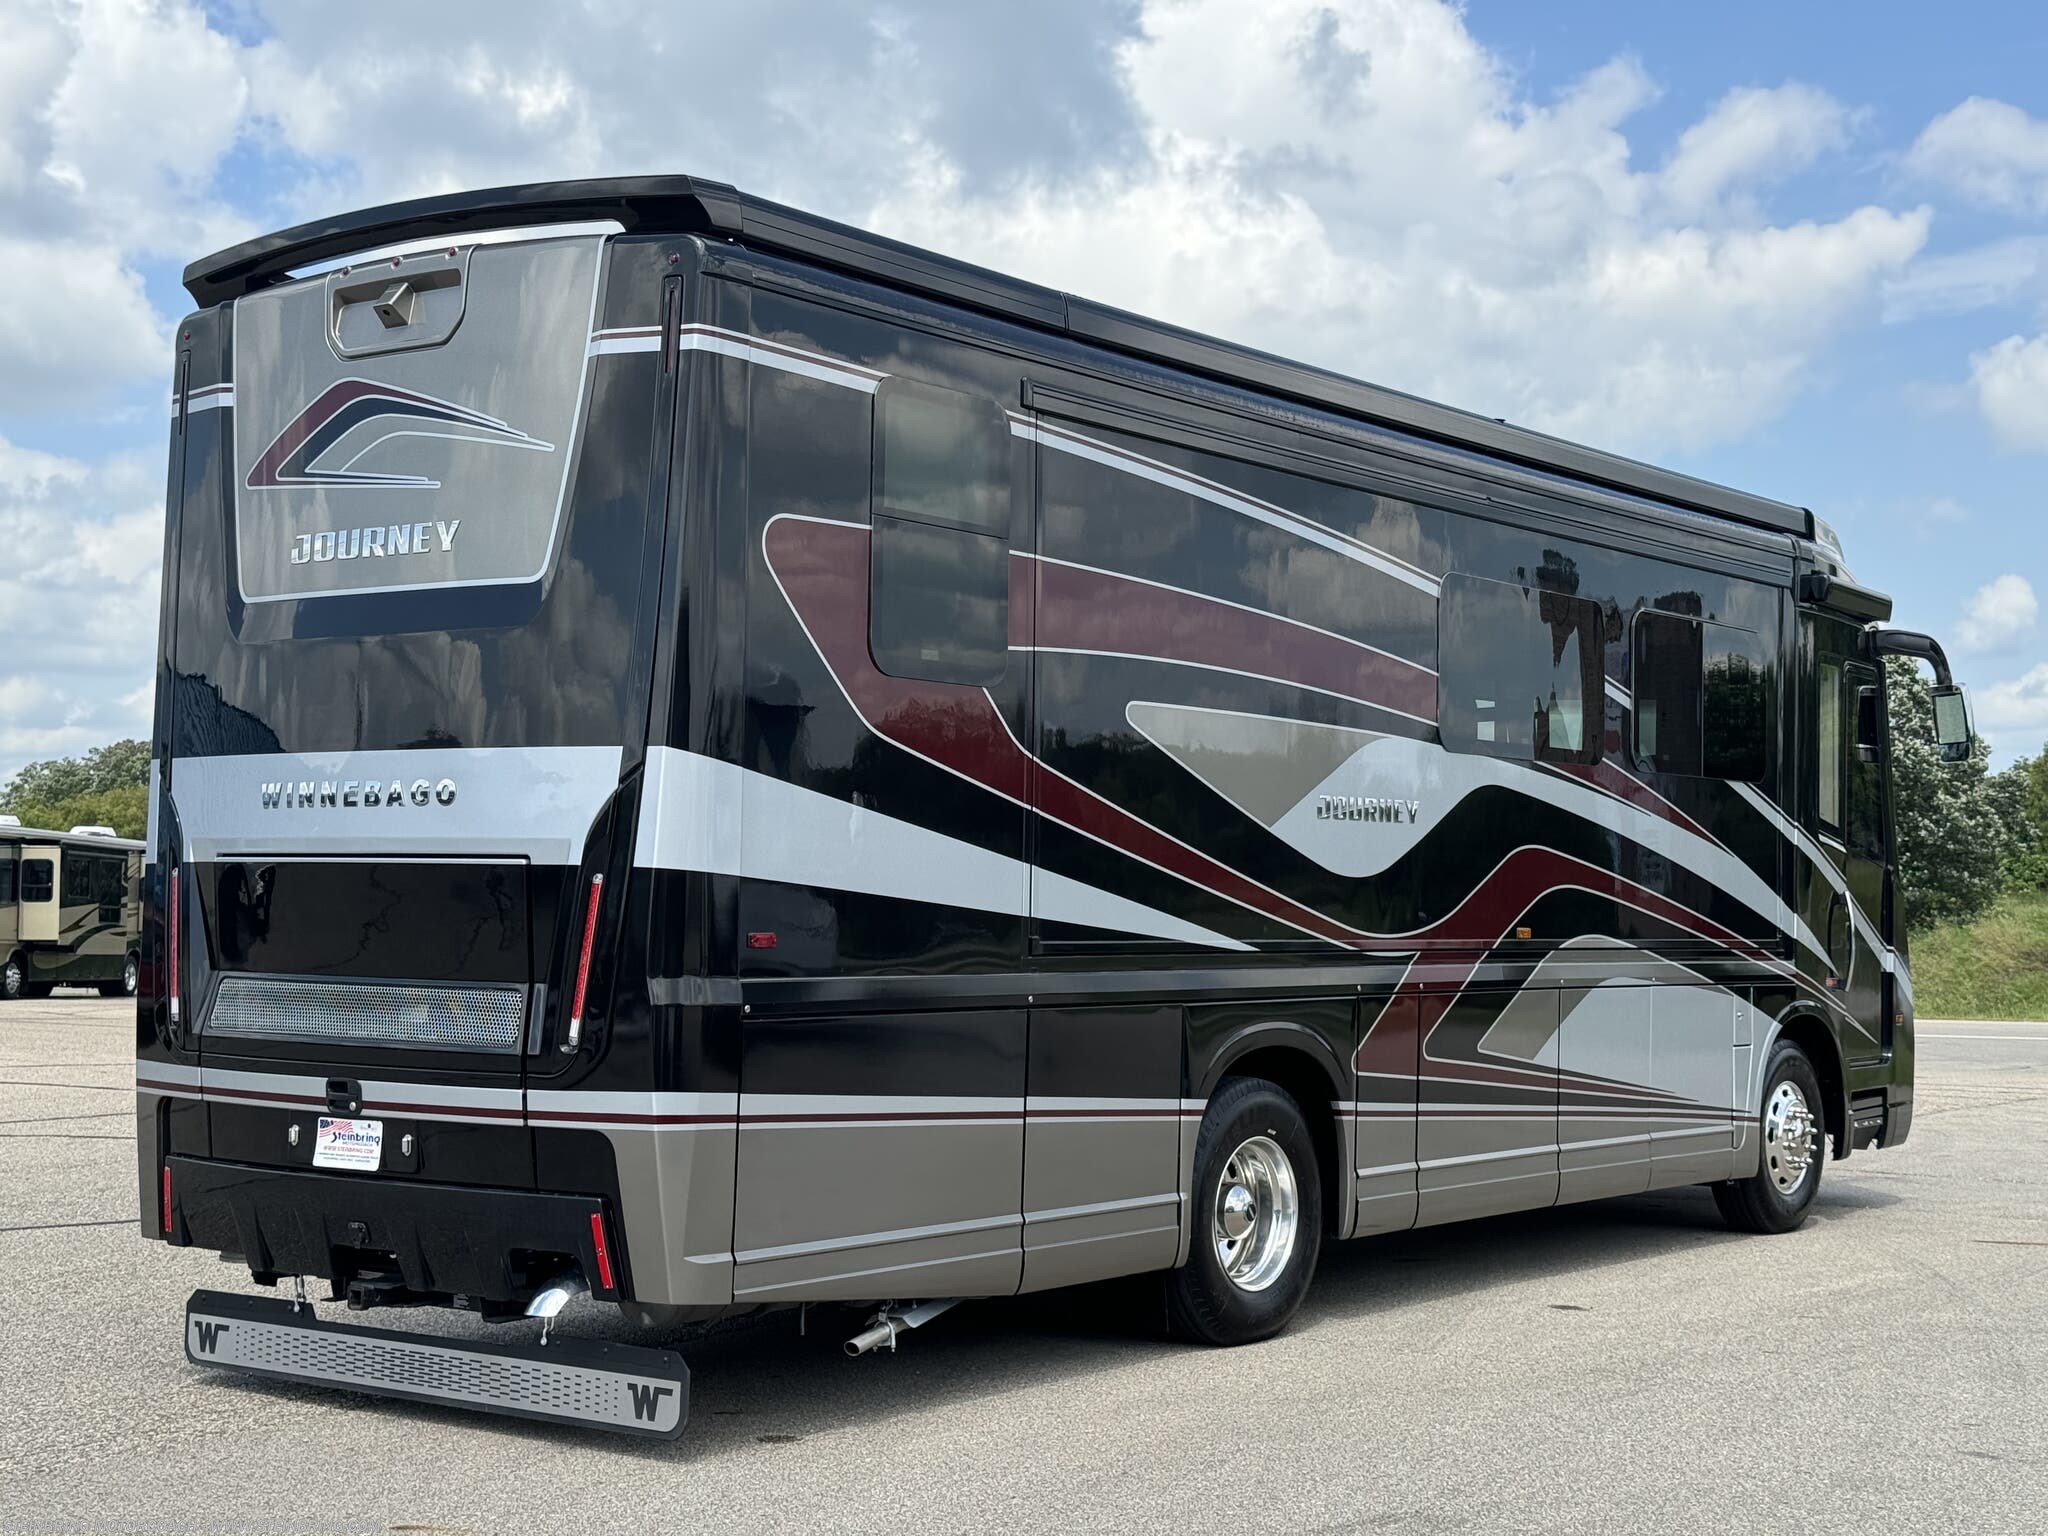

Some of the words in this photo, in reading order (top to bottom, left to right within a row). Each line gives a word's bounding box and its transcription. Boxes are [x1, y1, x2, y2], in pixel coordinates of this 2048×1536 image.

[290, 519, 462, 565] JOURNEY
[261, 778, 457, 809] WINNEBAGO
[1316, 795, 1420, 824] JOURNEY
[194, 1320, 230, 1354] W
[627, 1382, 673, 1422] W
